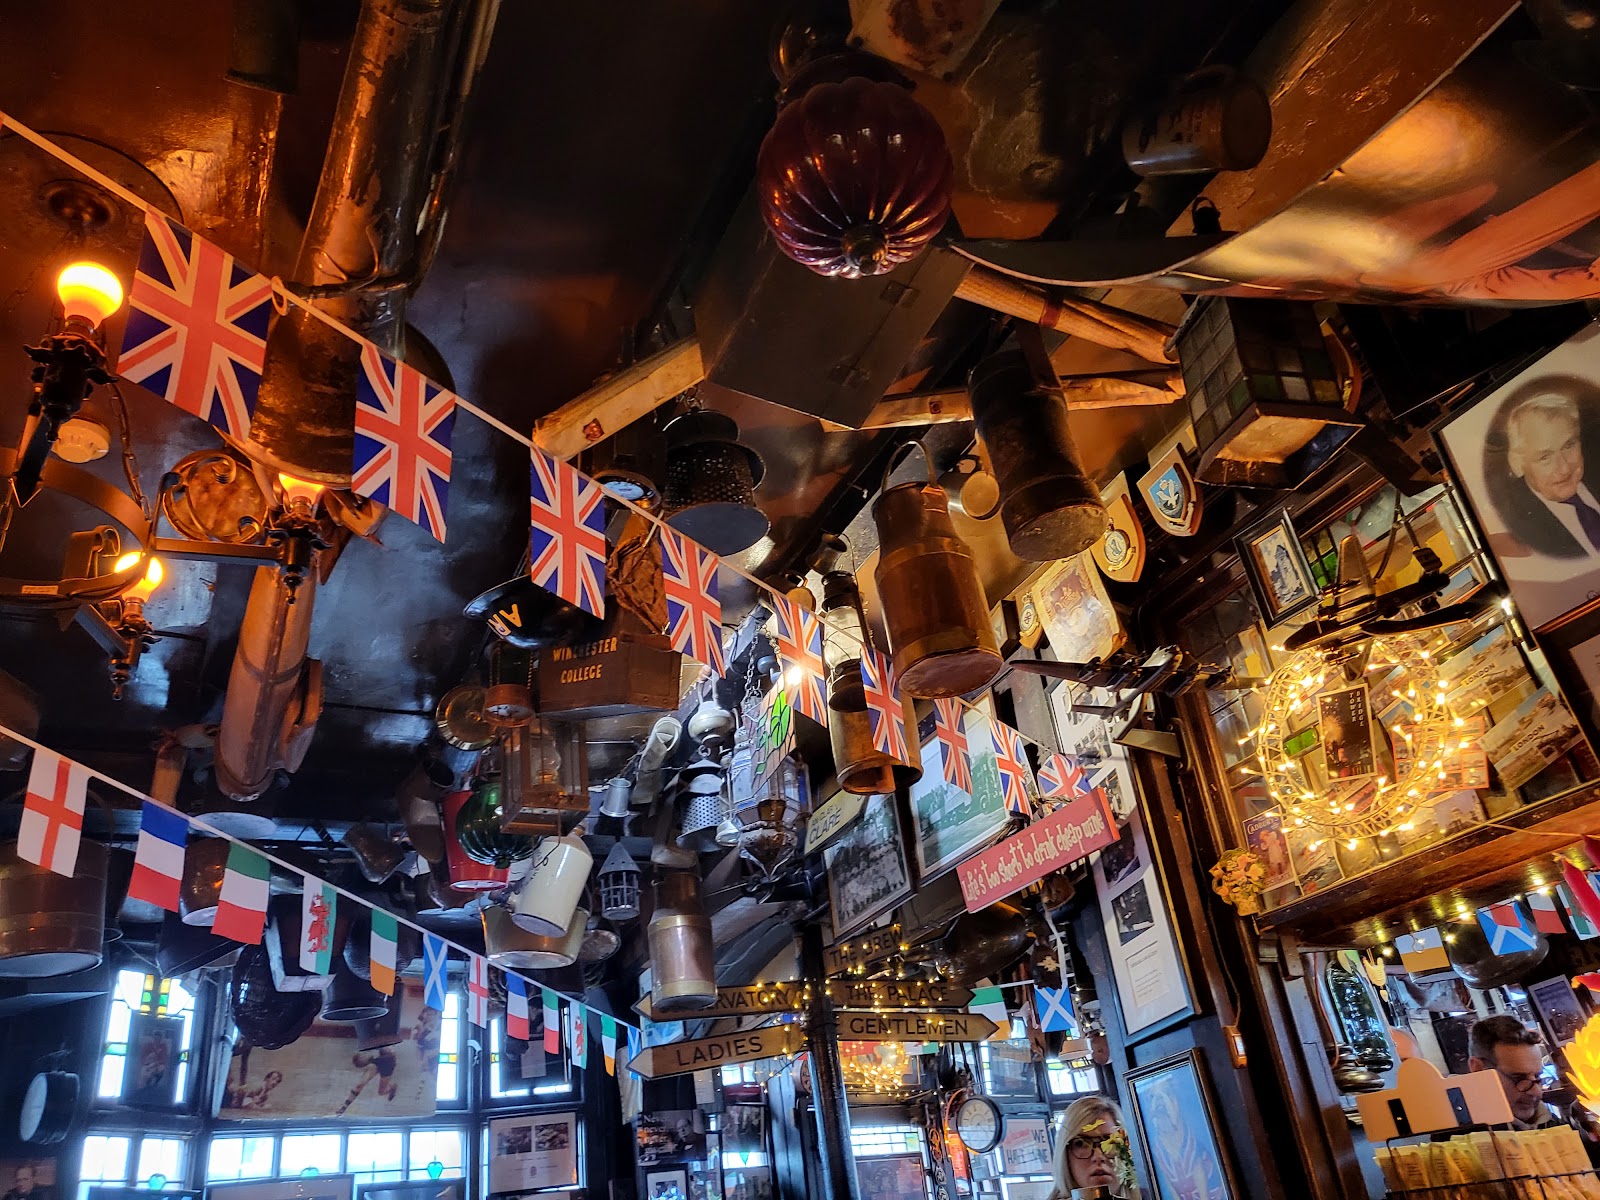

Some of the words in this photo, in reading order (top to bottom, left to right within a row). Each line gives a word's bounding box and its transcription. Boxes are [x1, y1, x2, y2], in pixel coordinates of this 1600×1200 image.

[488, 603, 522, 637] AR
[553, 637, 618, 662] WINCHESTER
[560, 664, 603, 685] COLLEGE
[1465, 662, 1496, 686] LONDON
[1349, 692, 1357, 723] TOWER
[1356, 690, 1364, 727] BRIDGE
[1513, 724, 1545, 751] LONDON
[961, 868, 987, 902] Life's
[981, 860, 1001, 889] too
[1017, 839, 1035, 869] to
[1030, 828, 1060, 866] drink
[1056, 821, 1085, 854] cheap
[1082, 809, 1105, 839] wine
[830, 943, 858, 967] THE
[865, 928, 903, 956] BREW
[702, 988, 793, 1012] RVATORY
[845, 985, 877, 1000] THE
[887, 986, 949, 1001] PALACE
[850, 1017, 968, 1036] GENTLEMEN
[677, 1036, 763, 1067] LADIES
[1031, 1129, 1046, 1144] WE
